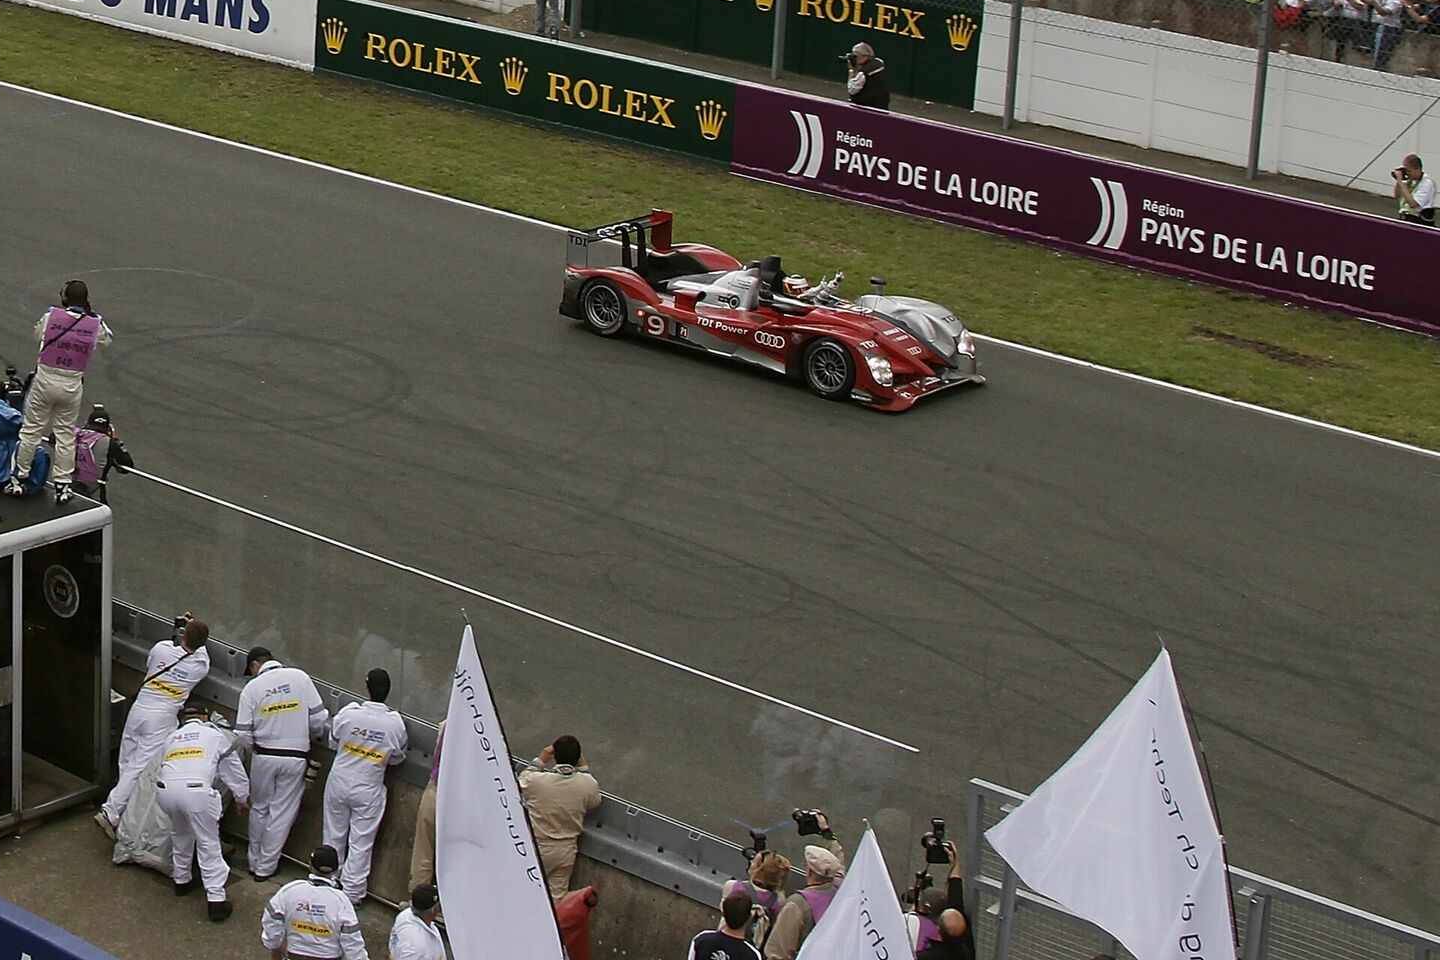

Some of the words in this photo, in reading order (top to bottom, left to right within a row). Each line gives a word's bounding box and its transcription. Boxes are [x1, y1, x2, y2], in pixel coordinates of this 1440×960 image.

[364, 31, 483, 85] ROLEX
[546, 71, 677, 129] ROLEX
[835, 129, 874, 150] Région
[833, 147, 890, 182] PAYS
[897, 165, 928, 190] DE
[933, 170, 964, 197] LA
[970, 177, 1039, 217] LOIRE
[1142, 198, 1185, 220] Région
[569, 234, 587, 247] TDI
[1140, 217, 1202, 253] PAYS
[1209, 234, 1248, 264] DE
[1254, 242, 1288, 272] LA
[1294, 249, 1377, 292] LOIRE
[647, 315, 665, 336] 9
[697, 316, 713, 328] TDI
[715, 321, 749, 336] Power
[941, 315, 960, 324] TDI
[859, 339, 878, 350] TDI
[265, 688, 277, 697] 24
[268, 702, 299, 712] DUNLOP
[351, 727, 367, 737] 24
[168, 748, 202, 759] DUNLOP
[351, 745, 383, 759] DUNLOP
[296, 903, 311, 912] 24
[297, 923, 330, 935] DUNLOP
